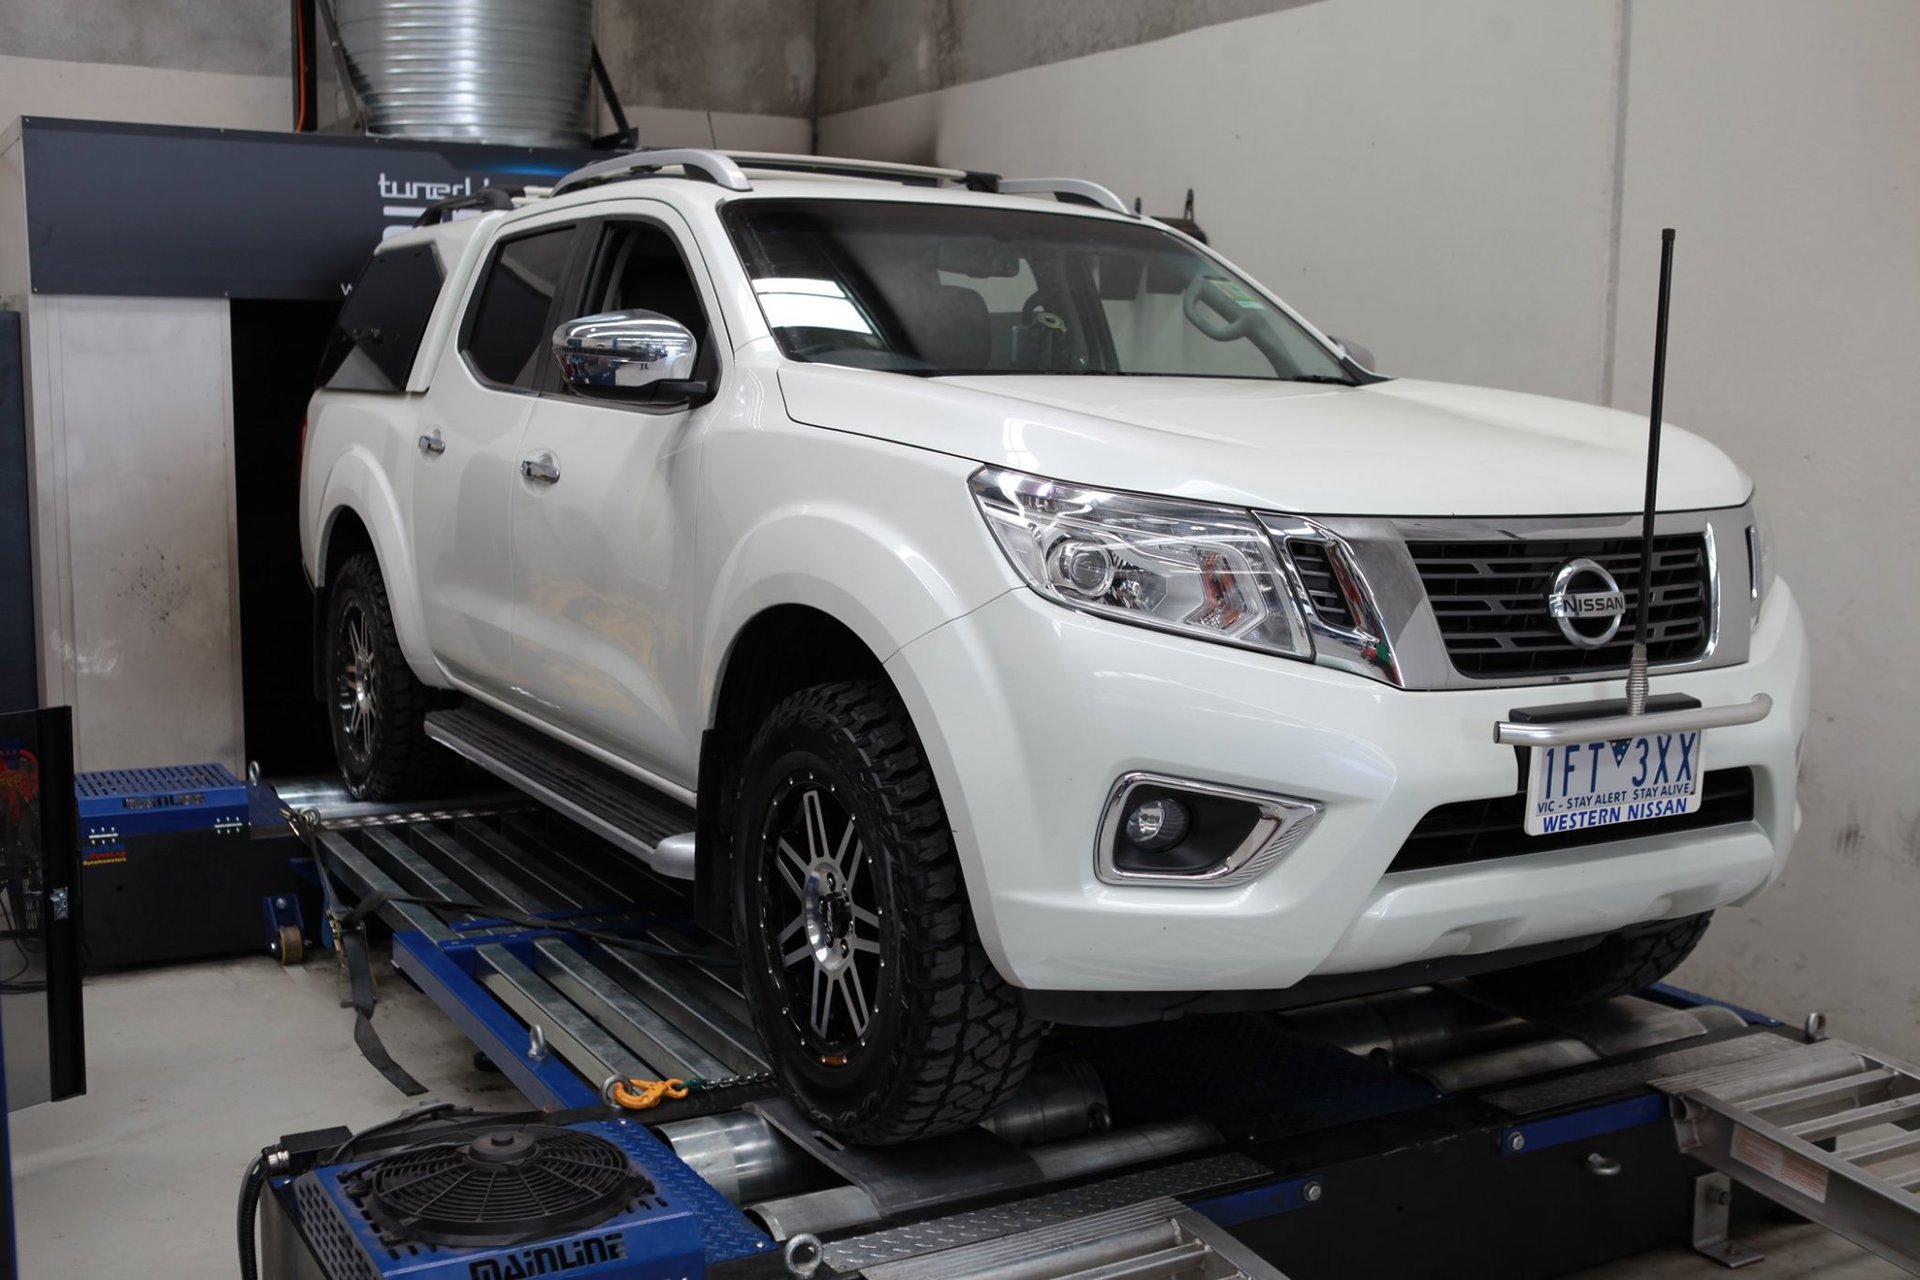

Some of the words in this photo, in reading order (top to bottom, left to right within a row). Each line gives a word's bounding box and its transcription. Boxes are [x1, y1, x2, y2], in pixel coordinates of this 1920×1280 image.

[1563, 595, 1624, 613] NISSAN
[1546, 744, 1605, 799] 1FT
[1632, 732, 1696, 787] 3XX
[1537, 801, 1555, 813] VIC
[1567, 795, 1593, 810] STAY
[1594, 791, 1627, 805] ALERT
[1633, 786, 1659, 801] STAY
[1660, 782, 1690, 797] ALIVE
[1543, 806, 1622, 833] WESTERN
[1627, 797, 1688, 820] NISSAN
